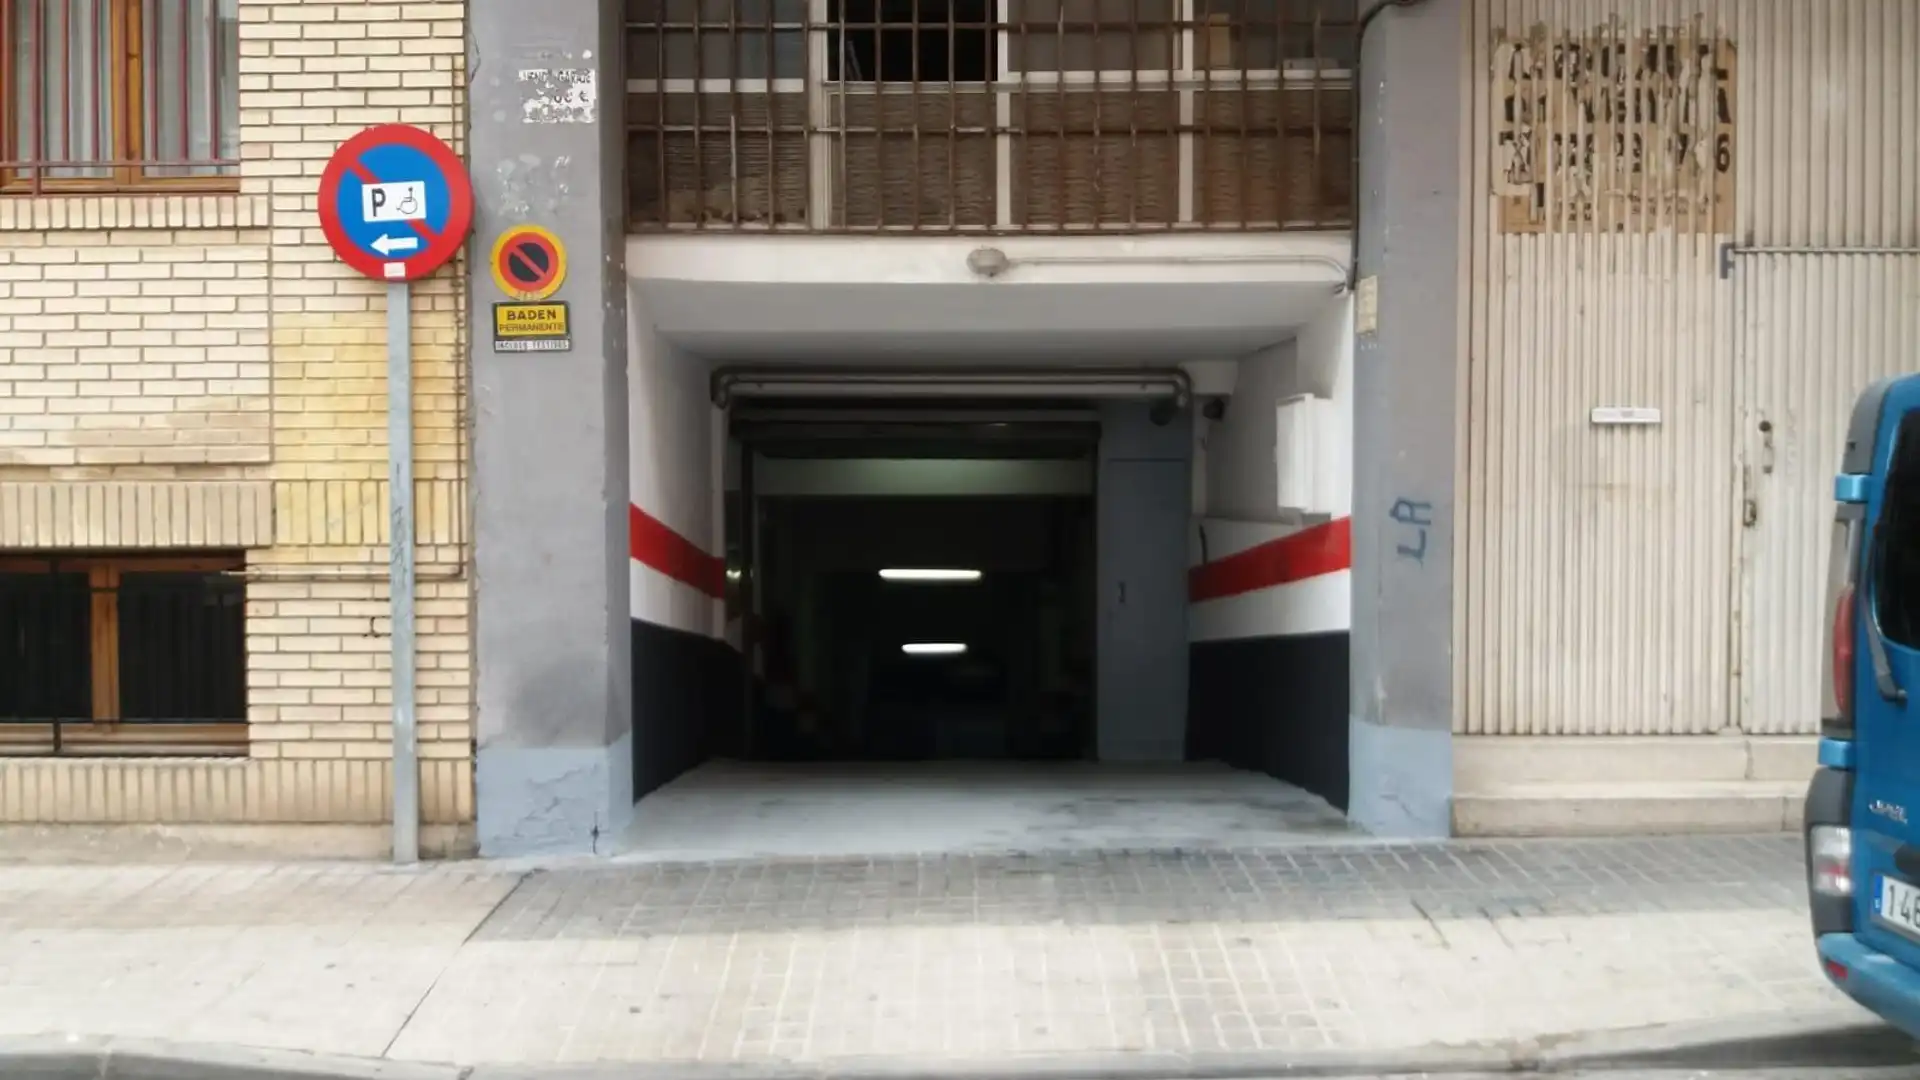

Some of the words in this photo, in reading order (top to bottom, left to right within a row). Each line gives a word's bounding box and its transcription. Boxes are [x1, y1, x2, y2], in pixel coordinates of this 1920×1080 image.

[371, 187, 387, 217] P
[506, 309, 557, 321] BADEN
[499, 322, 565, 333] PERMANENTE
